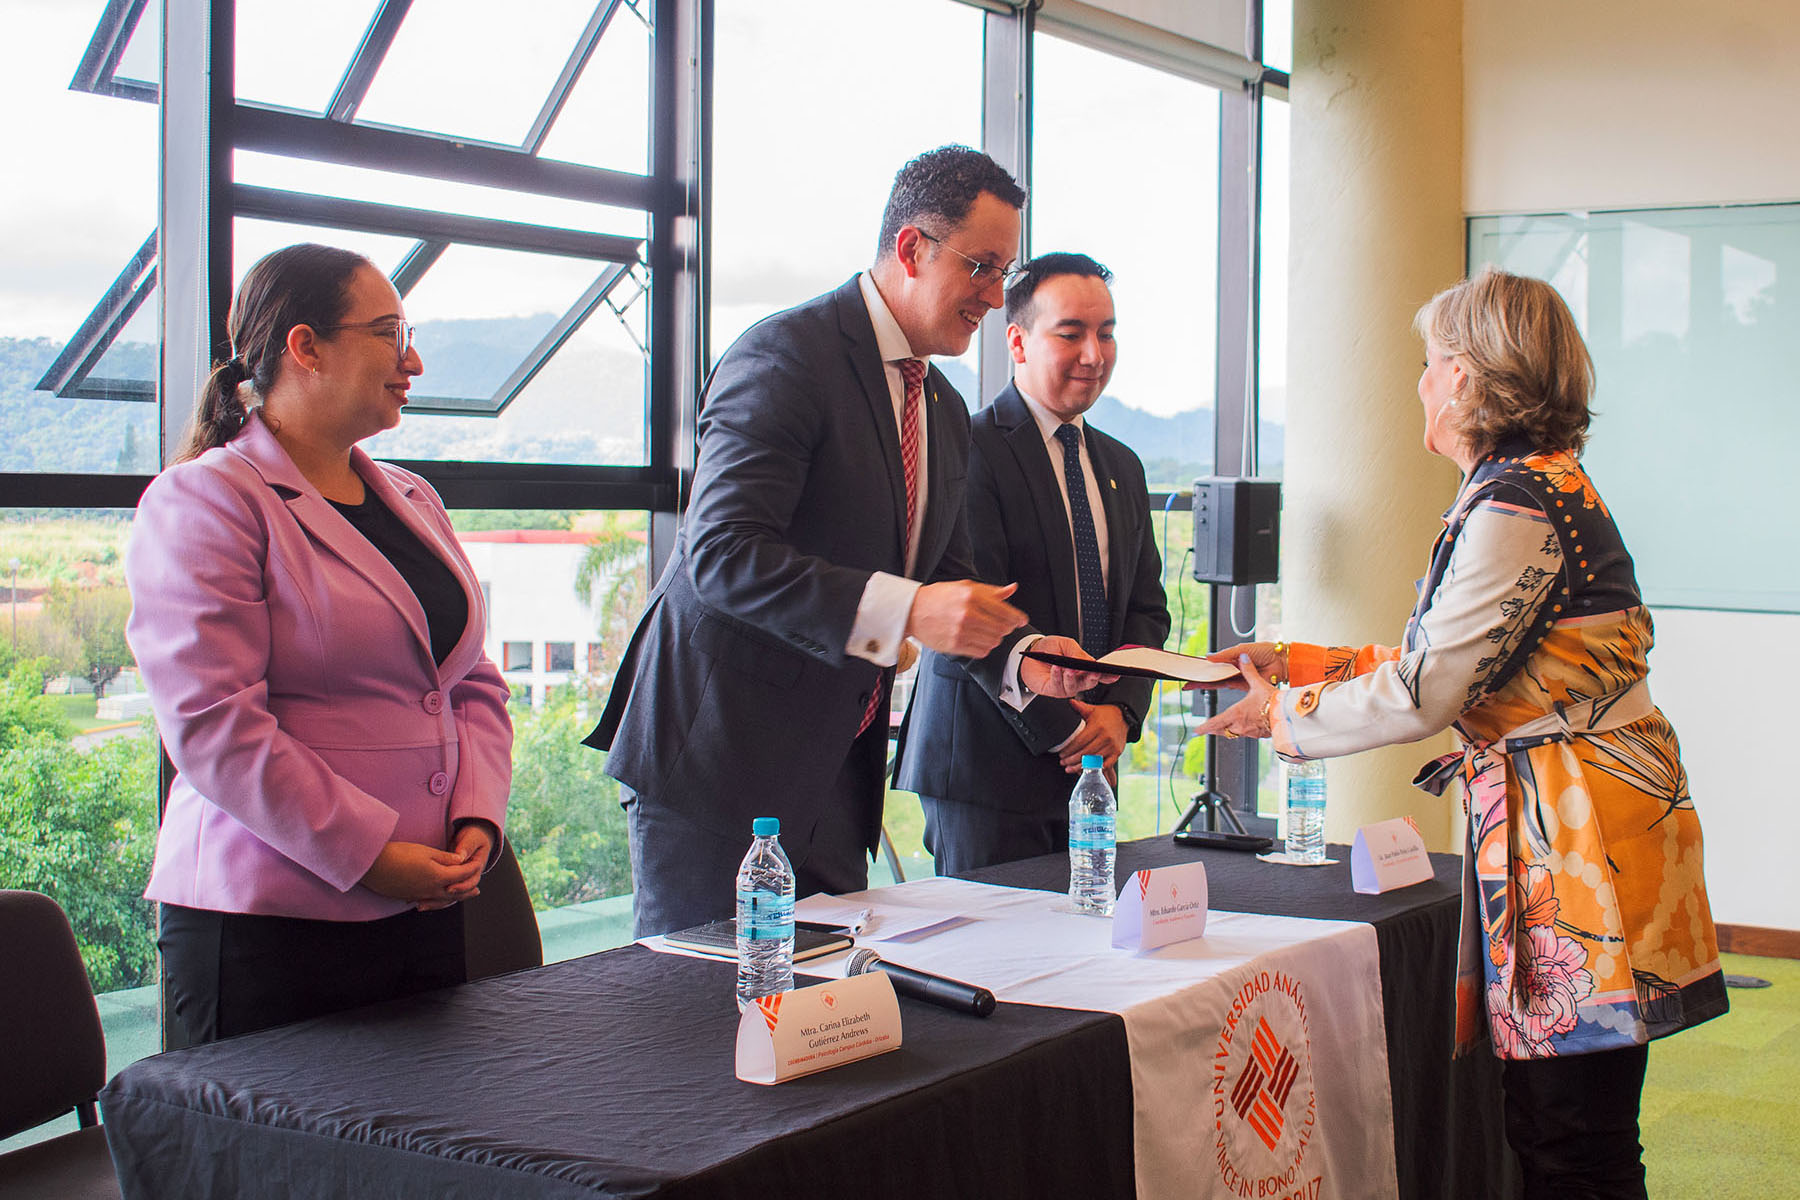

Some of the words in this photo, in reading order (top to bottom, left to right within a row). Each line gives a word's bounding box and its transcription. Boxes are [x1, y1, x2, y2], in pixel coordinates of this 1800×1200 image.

[800, 1027, 818, 1037] Mtra.
[820, 1021, 840, 1032] Carina
[841, 1012, 871, 1027] Elizabeth
[841, 1028, 869, 1040] Andrews
[1214, 970, 1270, 1117] UNIVERSIDAD
[1216, 1132, 1239, 1192] VINCE
[1239, 1177, 1254, 1198] IN
[1258, 1166, 1295, 1198] BONO
[1295, 1090, 1316, 1169] MALUM
